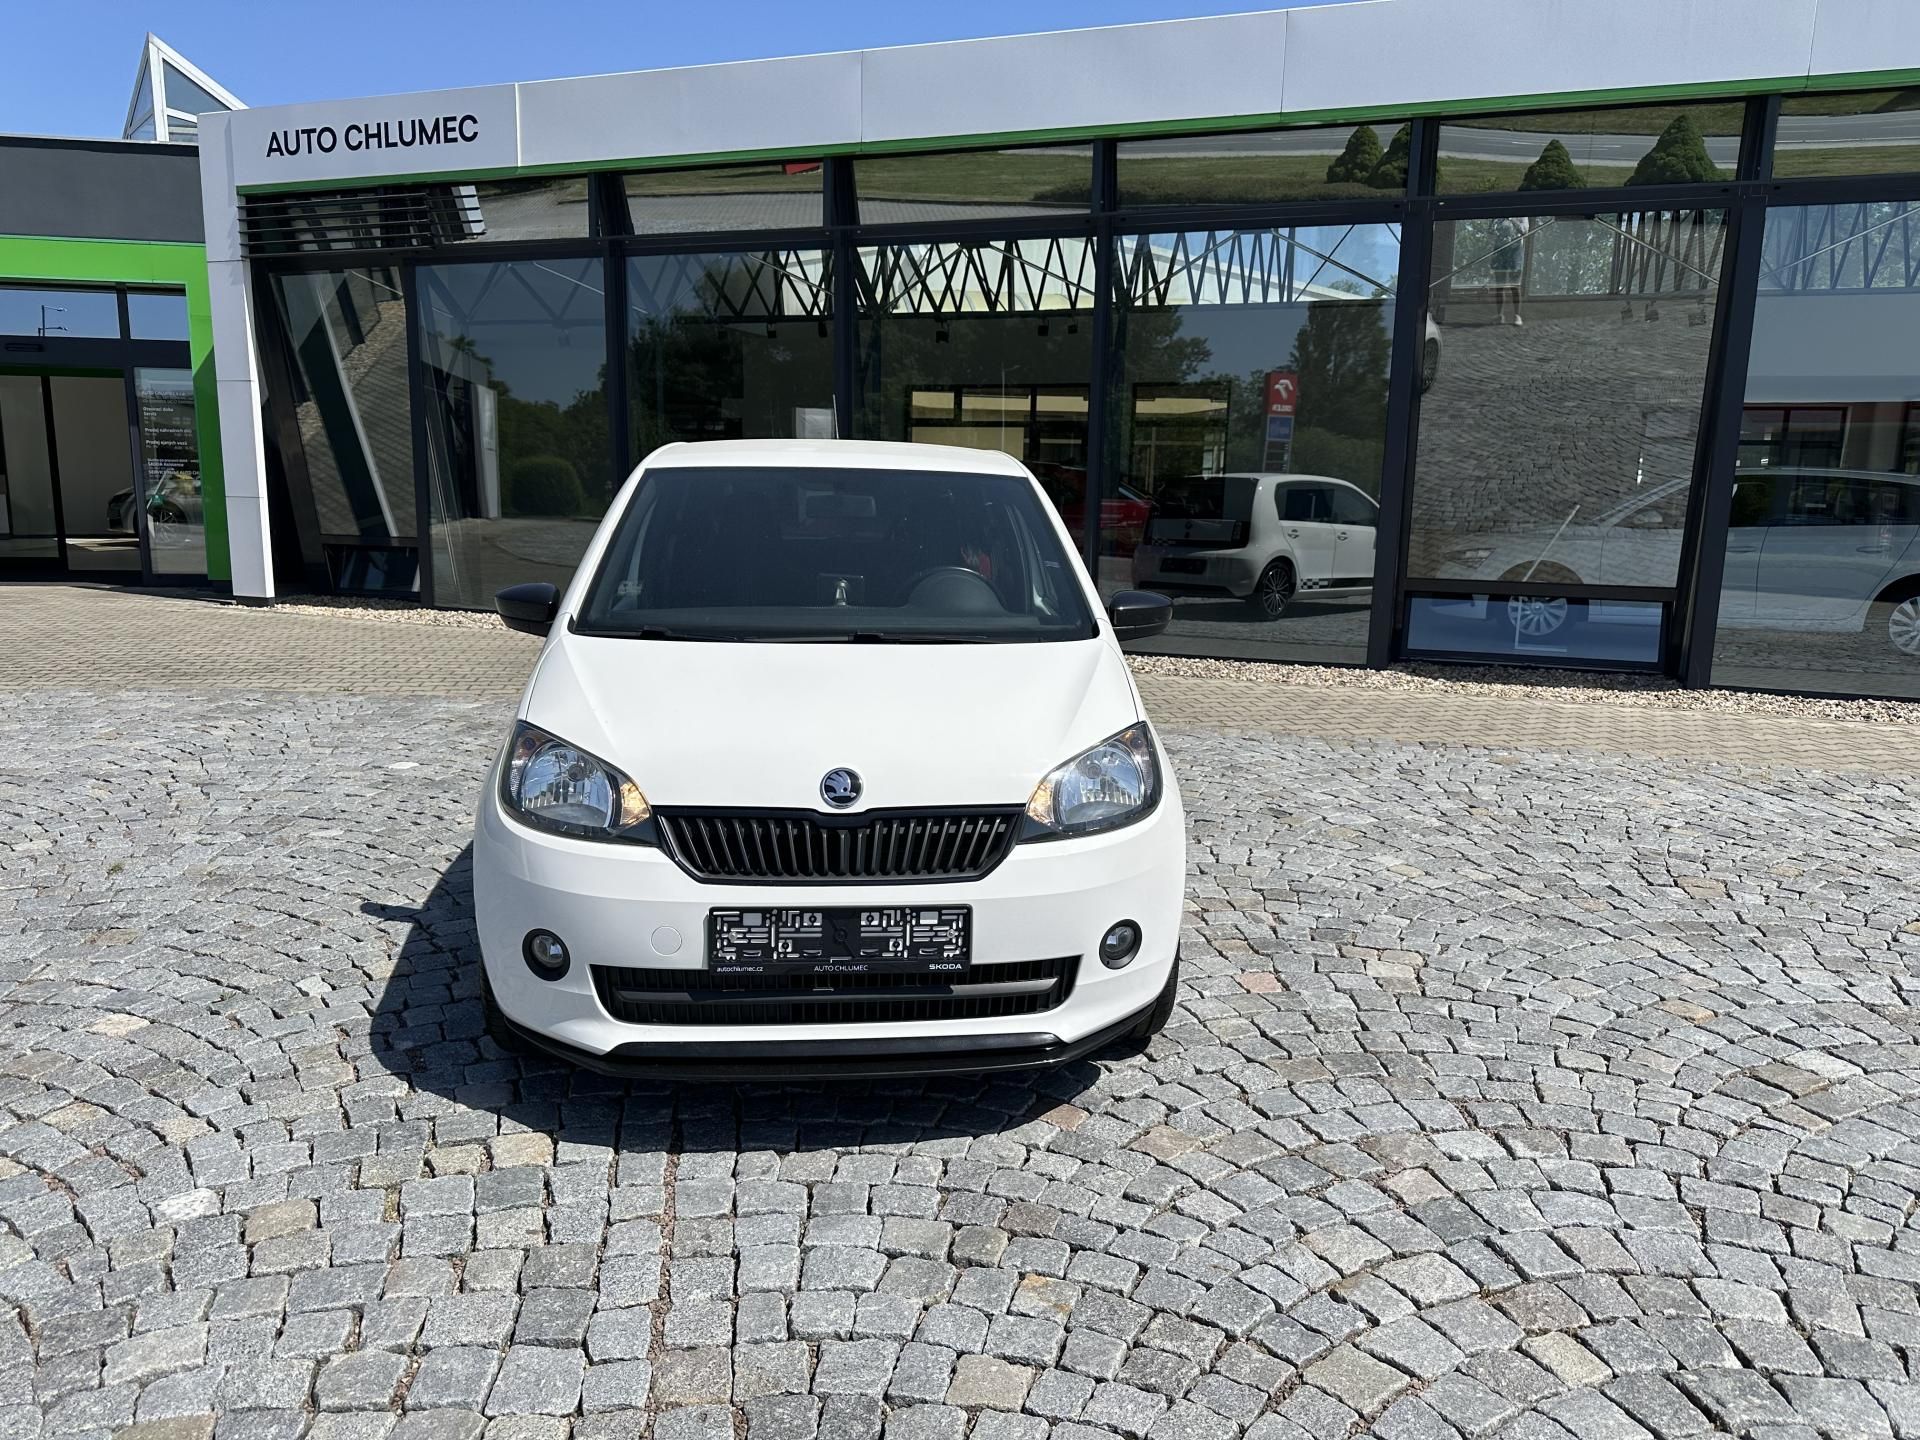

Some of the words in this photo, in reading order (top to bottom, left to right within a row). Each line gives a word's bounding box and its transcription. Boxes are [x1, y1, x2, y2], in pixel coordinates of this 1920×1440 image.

[266, 126, 337, 158] AUTO
[344, 114, 479, 151] CHLUMEC
[834, 964, 869, 972] CHLUMEC
